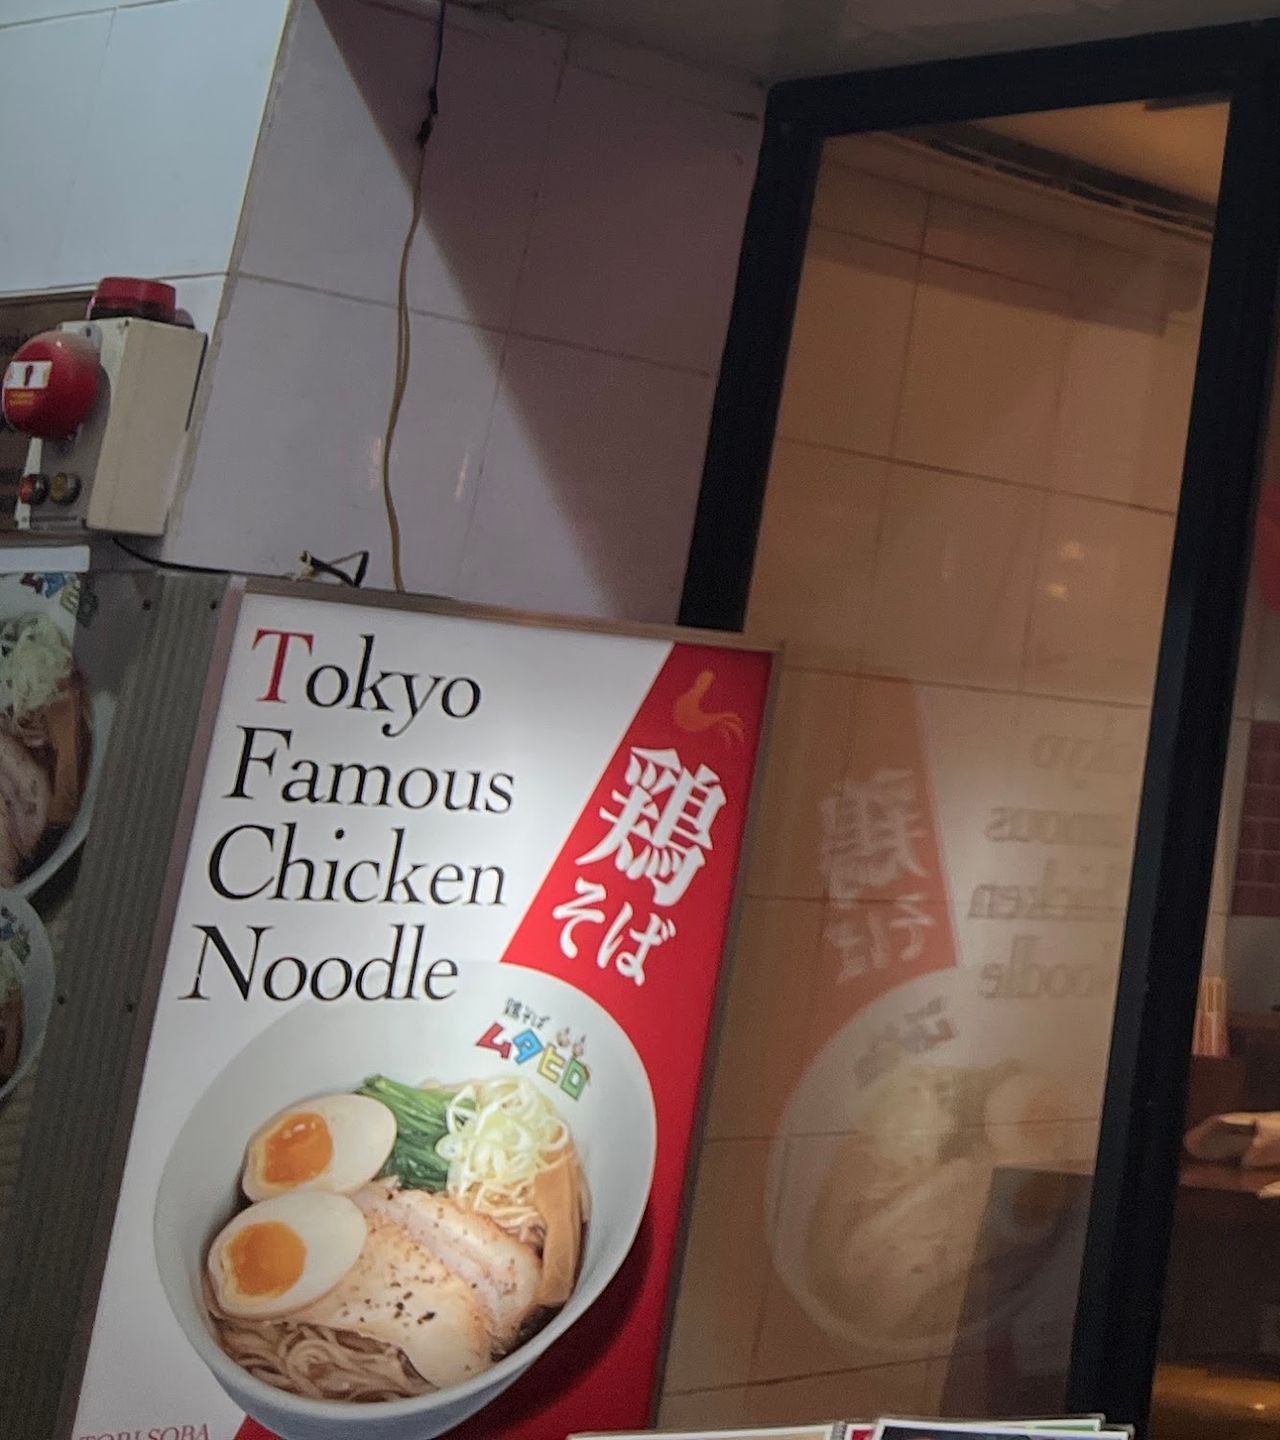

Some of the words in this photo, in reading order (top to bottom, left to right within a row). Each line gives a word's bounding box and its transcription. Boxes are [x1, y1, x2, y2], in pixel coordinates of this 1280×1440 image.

[251, 628, 482, 737] Tokyo
[223, 726, 515, 814] Famous
[208, 824, 507, 908] Chicken
[551, 745, 728, 987] 鶏そば
[178, 922, 459, 1002] Noodle
[475, 1022, 590, 1101] ムタヒロ
